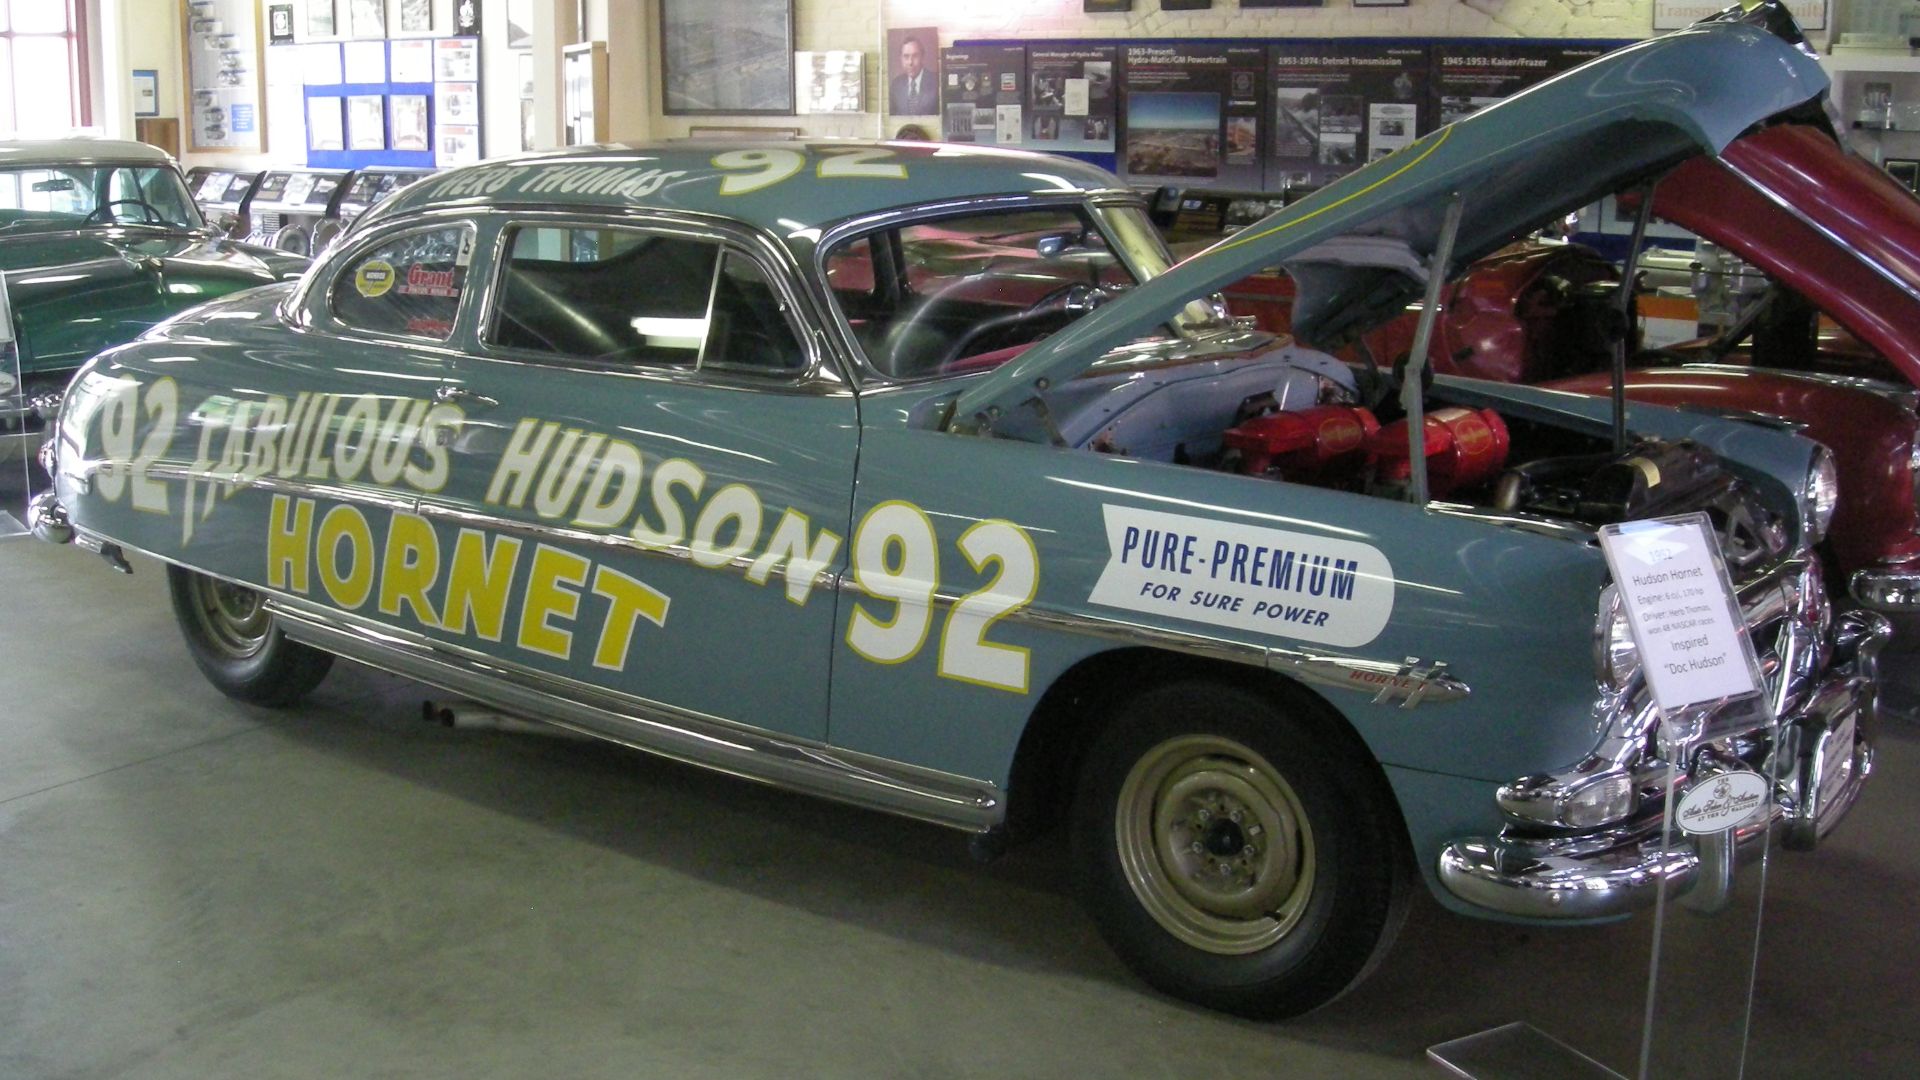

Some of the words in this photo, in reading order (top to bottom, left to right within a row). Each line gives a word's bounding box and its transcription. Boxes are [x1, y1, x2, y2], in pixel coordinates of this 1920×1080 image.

[1128, 48, 1176, 56] 1963-Present:
[1128, 56, 1186, 64] Hydra-Matic/GM
[1187, 56, 1227, 64] Powertrain
[1278, 57, 1321, 65] 1953-1974:
[1322, 57, 1350, 65] Detroit
[1351, 57, 1402, 66] Transmission
[1442, 57, 1489, 65] 1945-1953:
[1491, 58, 1547, 66] Kaiser/Frazer
[428, 165, 530, 199] HERB
[518, 164, 687, 198] THOMAS
[710, 147, 908, 196] 92
[408, 261, 455, 286] Grant
[96, 373, 179, 514] 92
[182, 391, 466, 548] FABULOUS
[486, 417, 842, 605] HUDSON
[1121, 526, 1358, 600] PURE-PREMIUM
[266, 493, 671, 671] HORNET
[1632, 572, 1669, 586] Hudson
[1669, 567, 1704, 580] Hornet
[846, 499, 1039, 694] 92
[1140, 582, 1181, 601] FOR
[1190, 590, 1243, 612] SURE
[1253, 601, 1330, 627] POWER
[1637, 594, 1665, 605] Engine:
[1642, 611, 1669, 622] Driver:
[1669, 608, 1685, 617] Herb
[1671, 619, 1697, 629] NASCAR
[1671, 634, 1709, 652] Inspired
[1349, 670, 1428, 691] HORNET
